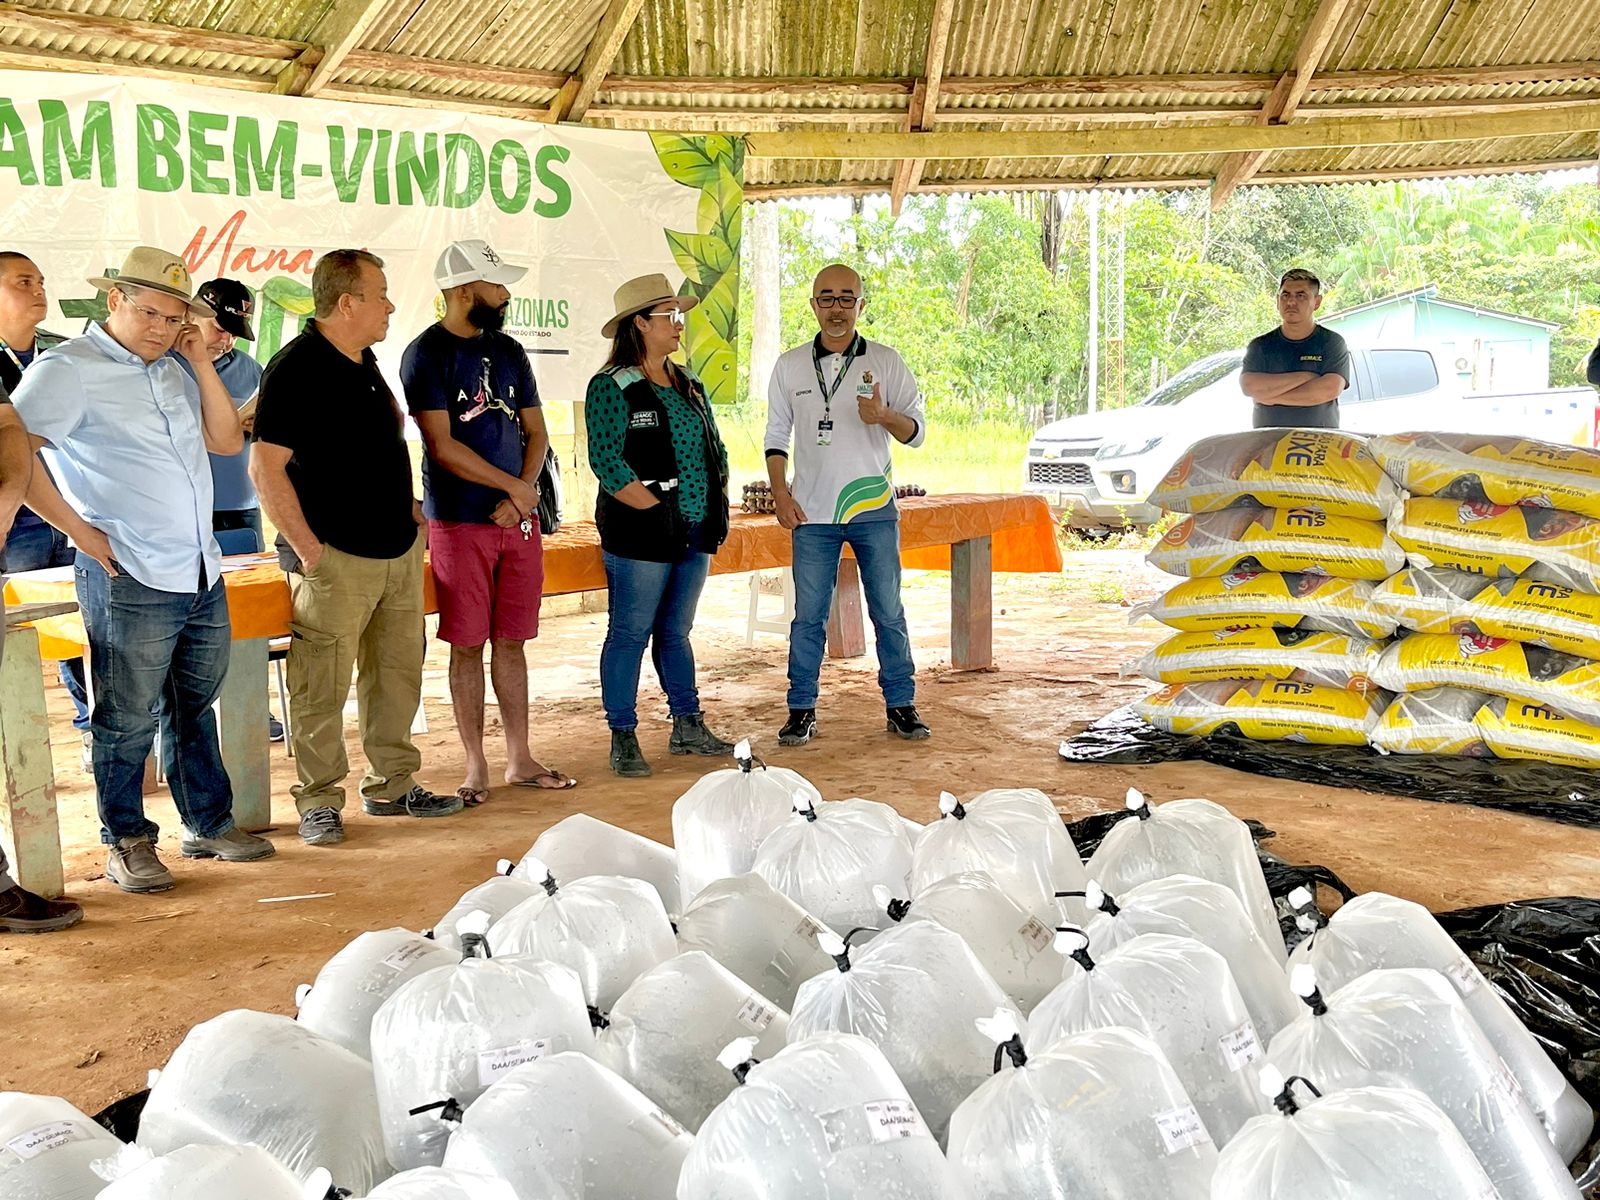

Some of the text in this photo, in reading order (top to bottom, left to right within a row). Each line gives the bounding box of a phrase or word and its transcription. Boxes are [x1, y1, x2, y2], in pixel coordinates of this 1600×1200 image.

[0, 97, 572, 218] AM BEM-VINDOS
[182, 209, 317, 279] Mana
[503, 297, 569, 328] AZONAS
[1286, 430, 1314, 468] EIXE
